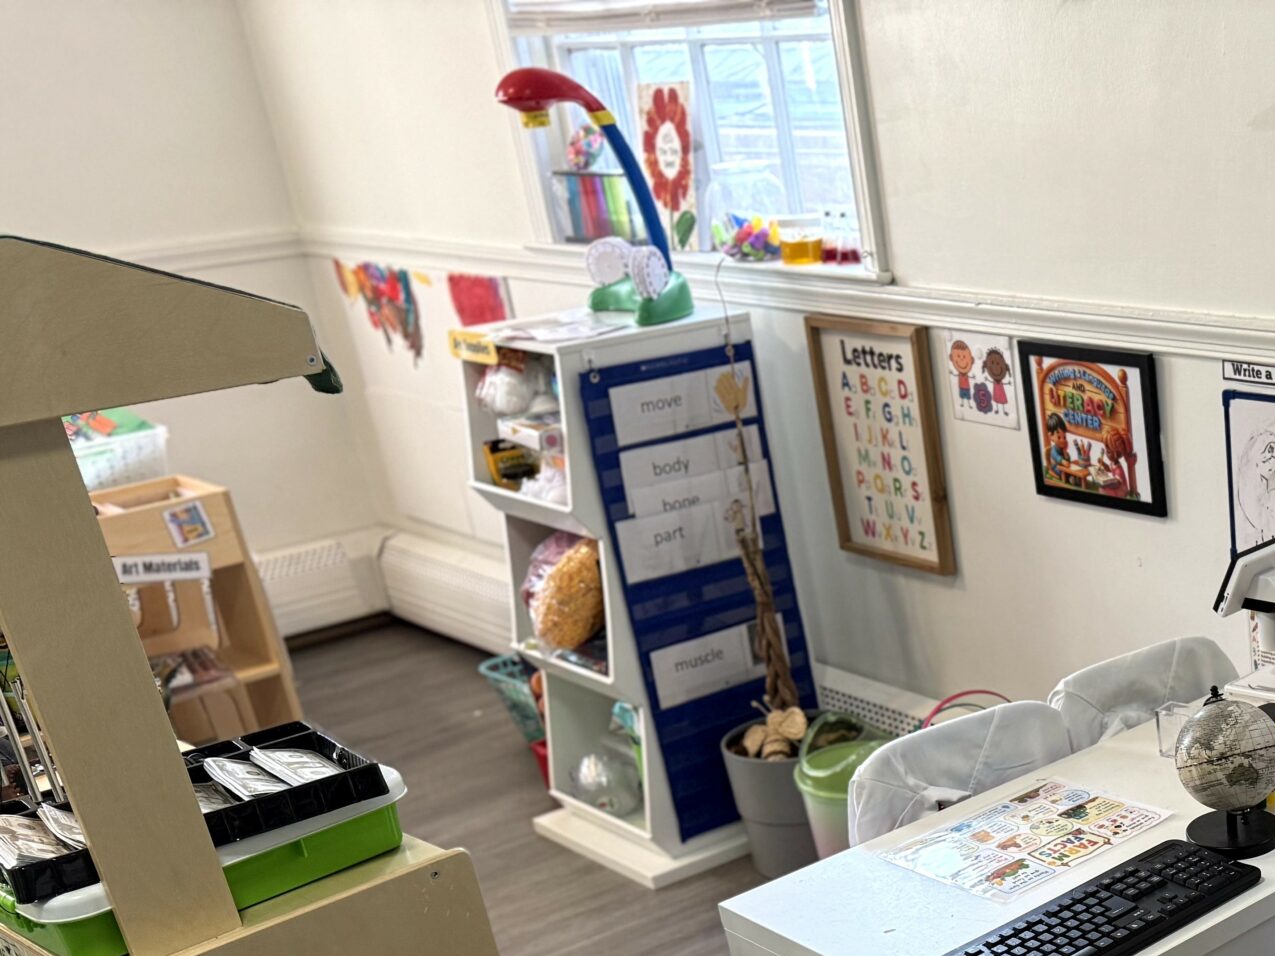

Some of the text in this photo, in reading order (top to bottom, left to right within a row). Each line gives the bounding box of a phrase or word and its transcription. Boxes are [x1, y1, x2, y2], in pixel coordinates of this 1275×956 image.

[840, 339, 904, 373] Letters
[1231, 362, 1262, 379] Write
[1265, 369, 1273, 380] a
[1072, 382, 1086, 393] AND
[640, 394, 683, 415] move
[1063, 408, 1102, 431] CENTER
[652, 458, 690, 477] body
[662, 494, 700, 513] bone
[653, 527, 686, 547] part
[121, 558, 201, 576] Art Materials
[674, 648, 725, 673] muscle
[1042, 834, 1085, 858] FACTS
[1050, 838, 1100, 863] FARM
